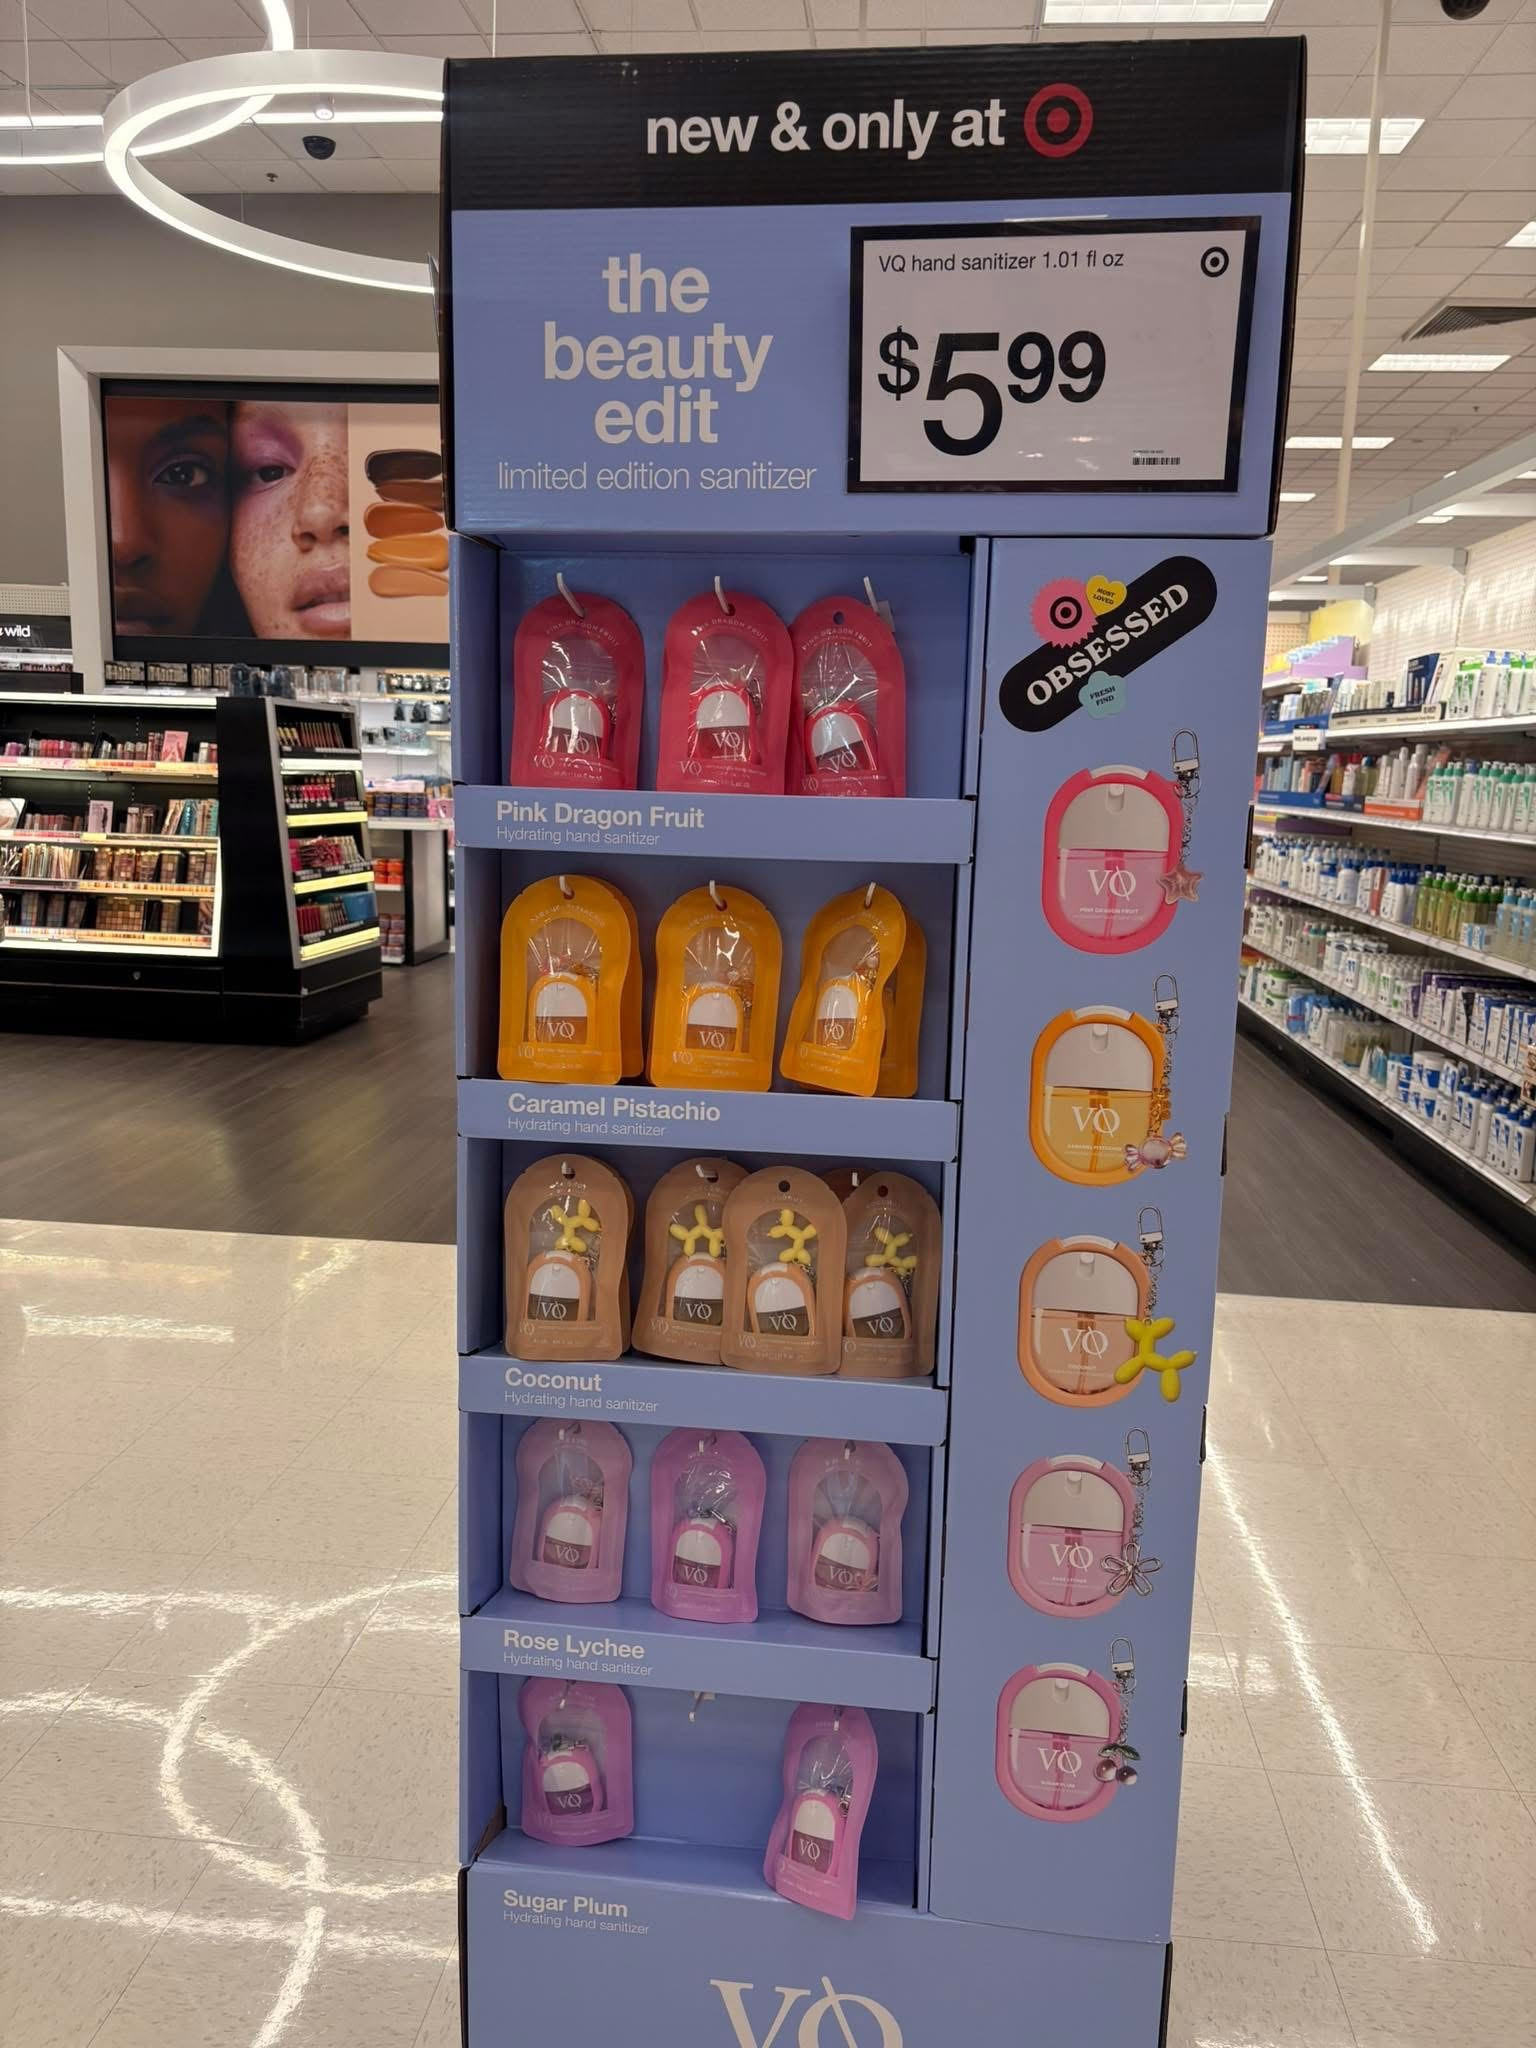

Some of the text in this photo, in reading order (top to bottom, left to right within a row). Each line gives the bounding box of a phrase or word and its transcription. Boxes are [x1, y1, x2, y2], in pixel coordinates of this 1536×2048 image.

[647, 99, 1006, 160] new & only at
[879, 250, 1125, 273] VQ hand sanitizer 1.01 fl oz
[602, 253, 710, 313] the
[544, 321, 774, 392] beauty
[594, 384, 720, 444] edit
[498, 460, 817, 490] limited edition sanitizer
[1093, 593, 1114, 605] LOVED
[4, 624, 31, 638] wild
[1026, 583, 1190, 707] OBSESSED
[1089, 685, 1116, 700] FRESH
[1095, 694, 1115, 706] FIND
[496, 800, 705, 830] Pink Dragon Fruit
[497, 826, 661, 846] Hydrating hand sanitizer
[508, 1092, 721, 1122] Caramel Pistachio
[508, 1117, 666, 1137] Hydrating hand sanitizer
[505, 1367, 603, 1391] Coconut
[504, 1391, 659, 1413] Hydrating hand sanitizer
[504, 1629, 645, 1659] Rose Lychee
[503, 1652, 653, 1676] Hydrating hand sanitizer
[504, 1889, 629, 1917] Sugar Plum
[503, 1910, 650, 1935] Hydrating hand sanitizer
